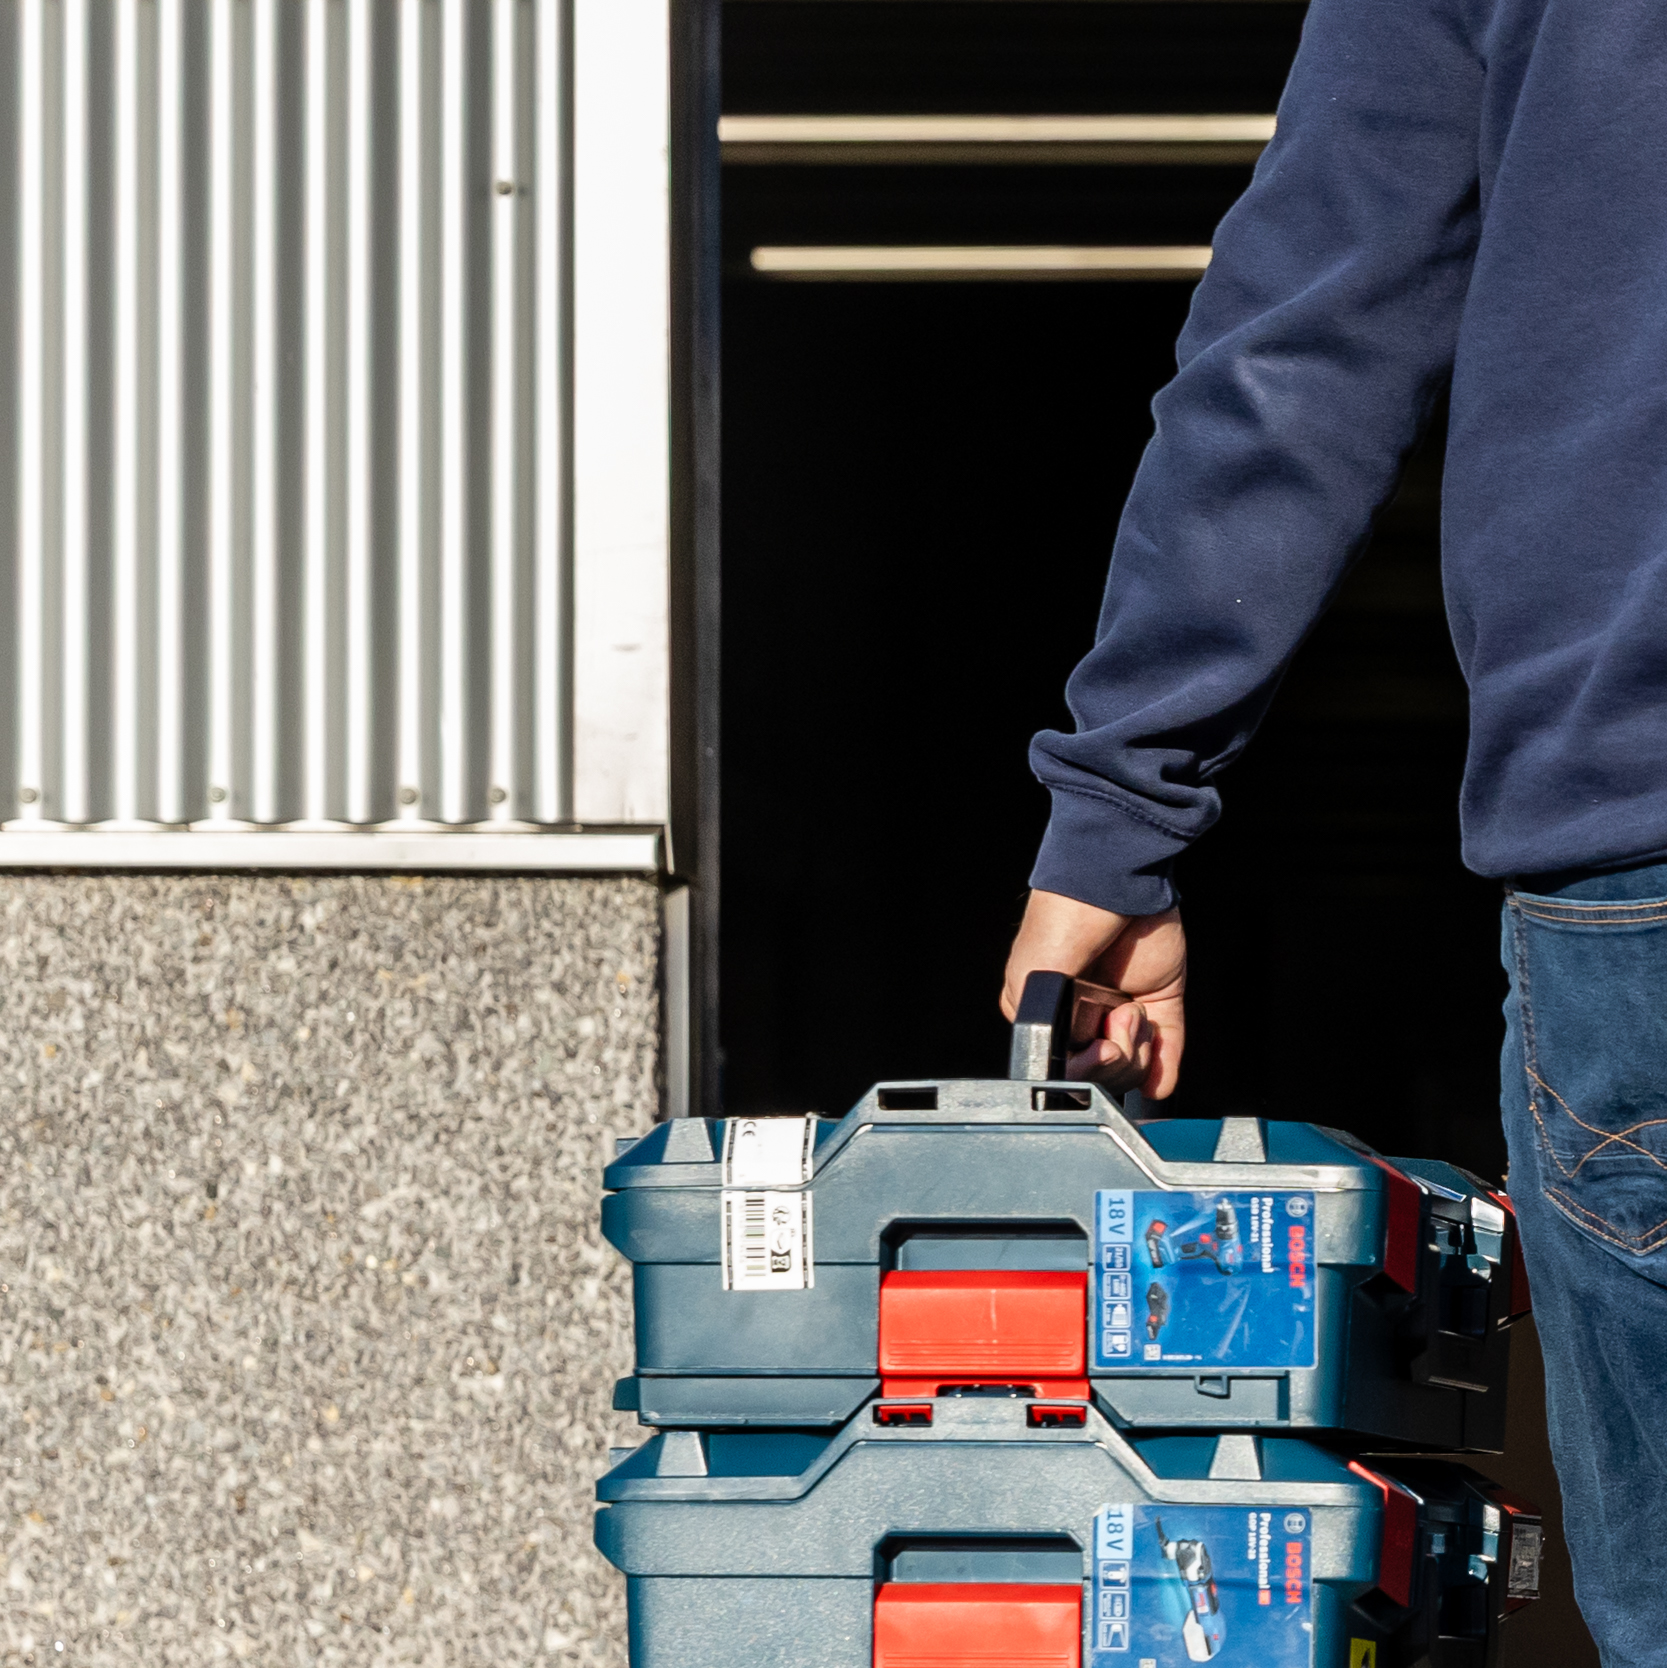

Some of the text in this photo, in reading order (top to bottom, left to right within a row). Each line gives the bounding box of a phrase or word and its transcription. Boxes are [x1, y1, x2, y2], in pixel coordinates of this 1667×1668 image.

[1108, 1198, 1126, 1235] 18 V
[1261, 1197, 1274, 1273] Professional
[1288, 1225, 1306, 1287] BOSCH
[1106, 1509, 1124, 1551] 18 V
[1258, 1512, 1271, 1588] Professional
[1286, 1542, 1303, 1604] BOSCH
